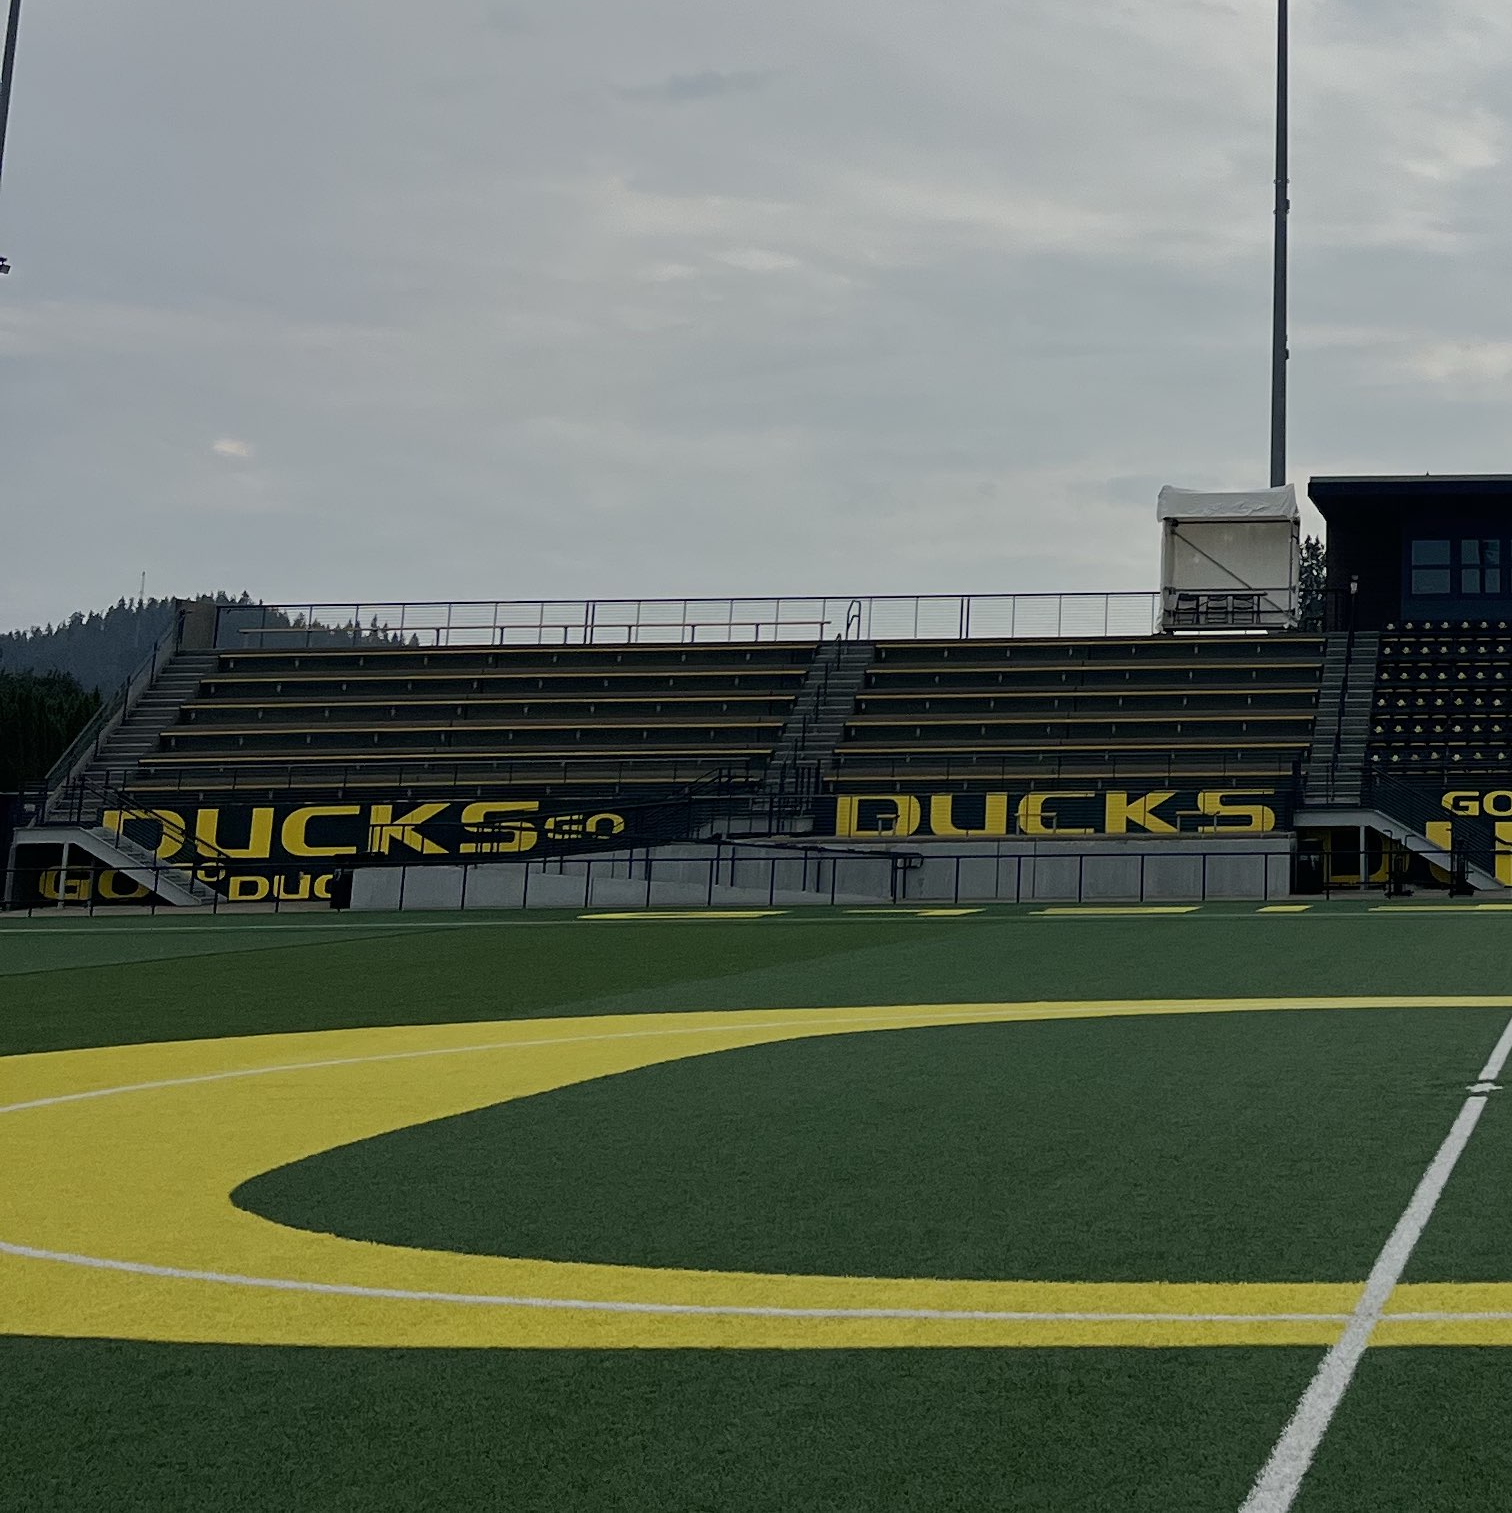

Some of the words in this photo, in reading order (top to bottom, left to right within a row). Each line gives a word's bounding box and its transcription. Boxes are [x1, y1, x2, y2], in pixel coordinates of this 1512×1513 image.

[102, 800, 540, 859] DUCKS
[543, 813, 625, 840] GO
[835, 789, 1276, 840] DUCKS
